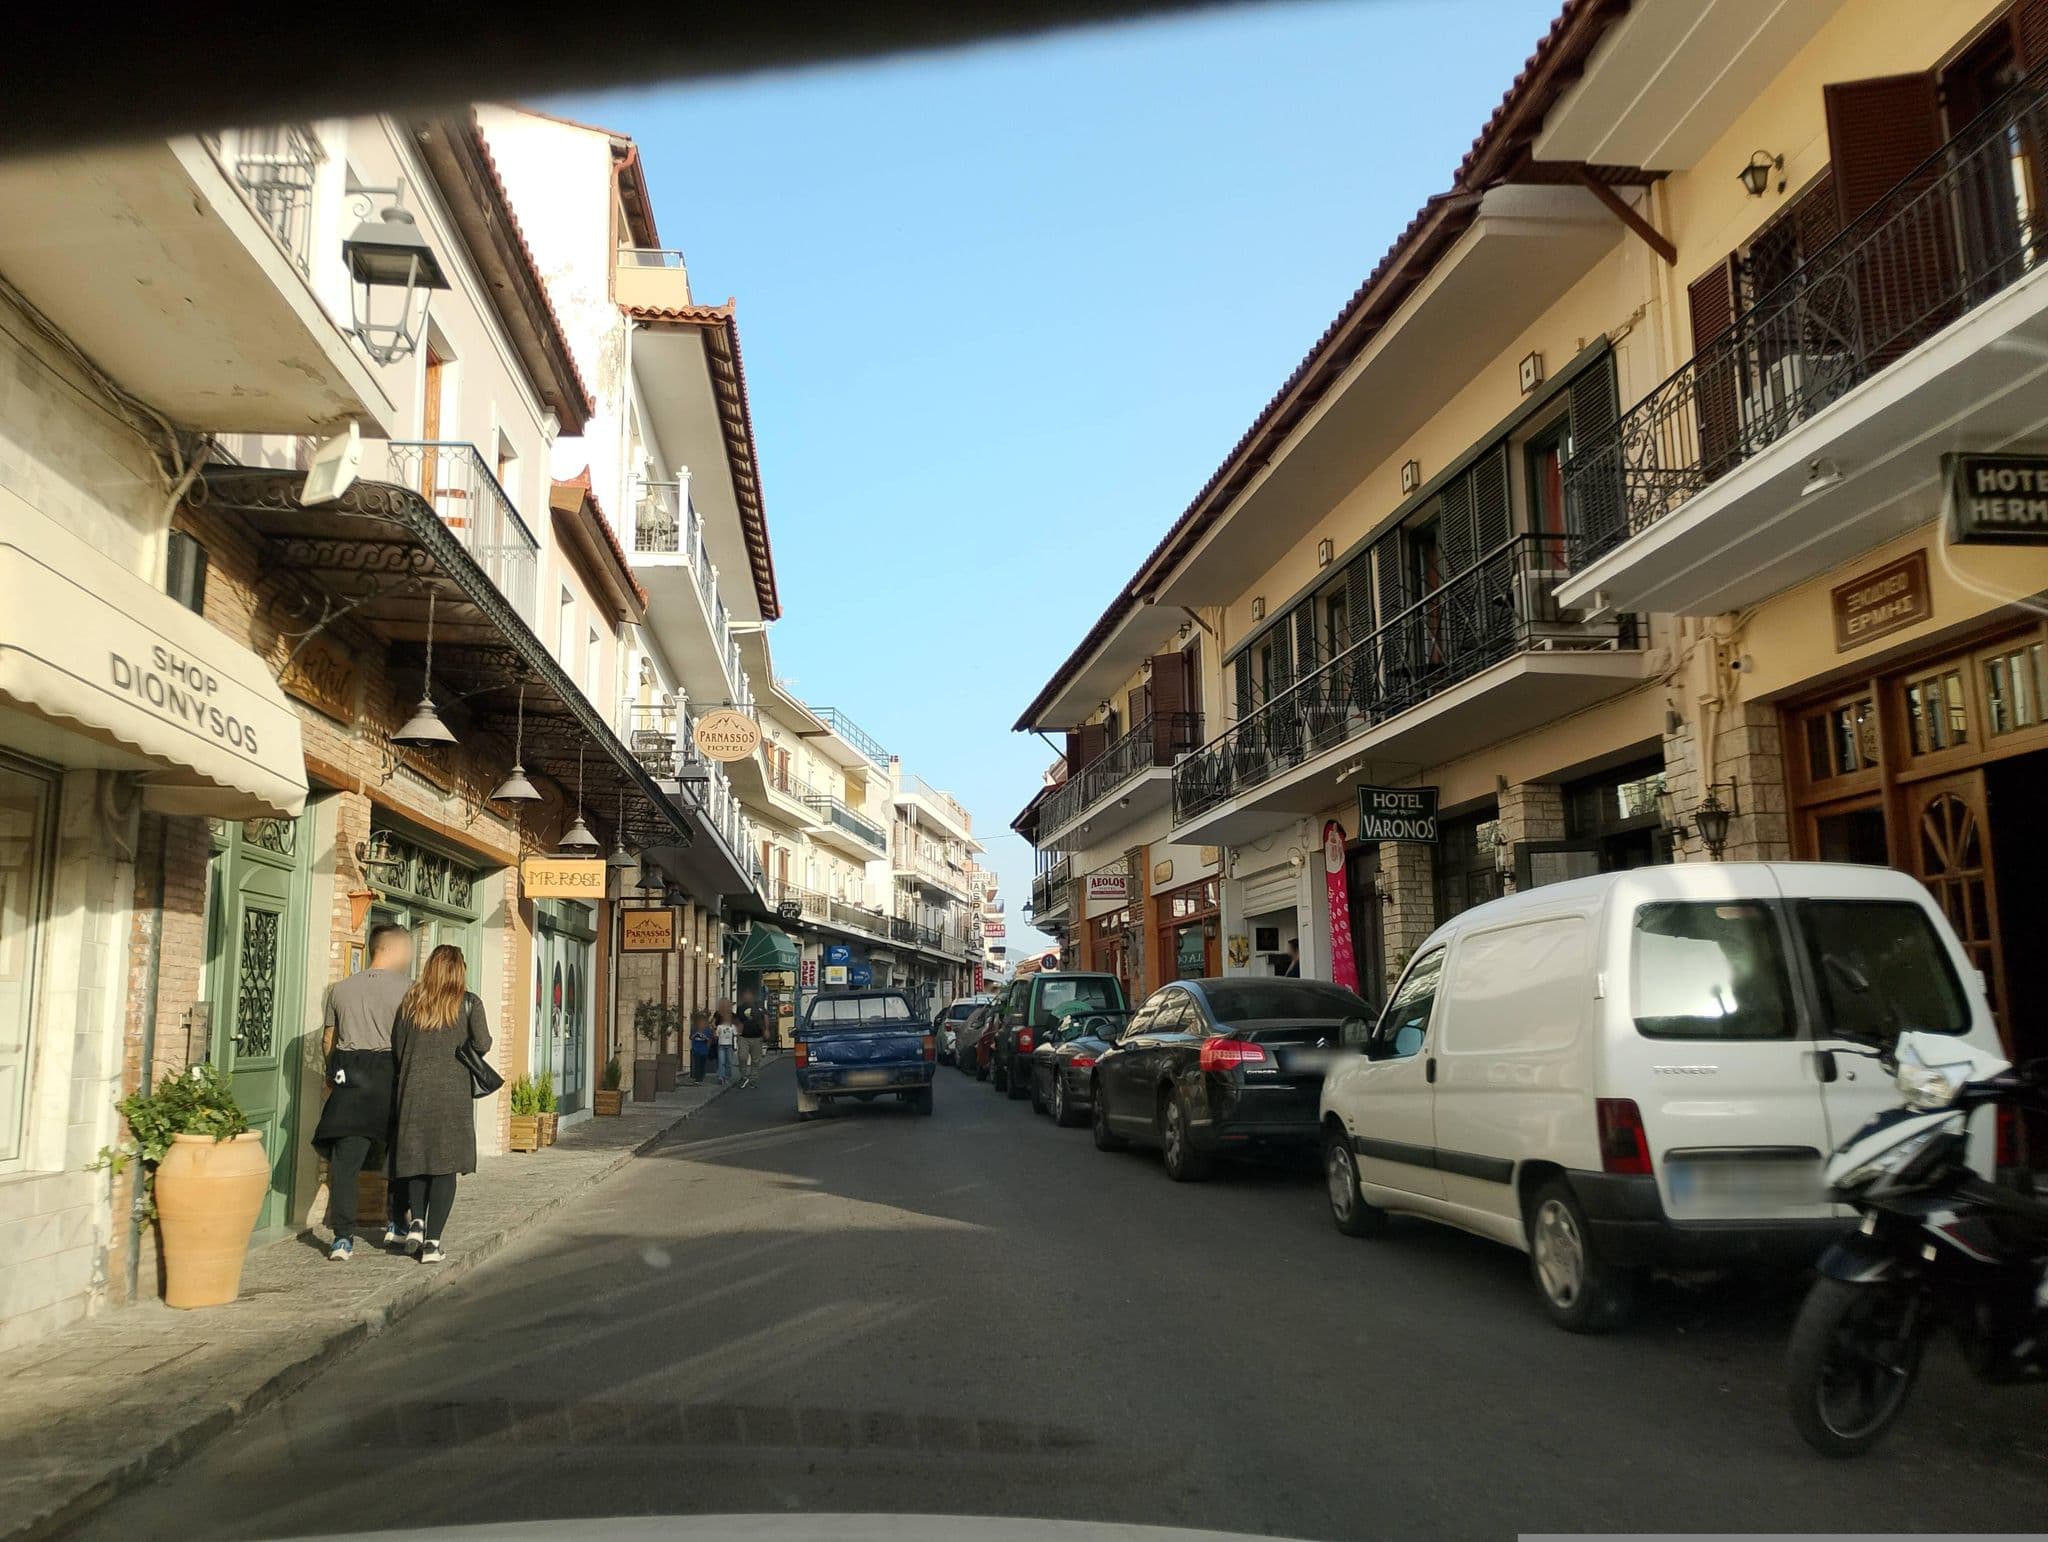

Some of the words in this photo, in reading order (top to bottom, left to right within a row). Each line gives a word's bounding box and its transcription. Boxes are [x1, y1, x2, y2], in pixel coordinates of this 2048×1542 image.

[1976, 469, 2048, 493] HOTE
[153, 645, 218, 697] SHOP
[111, 652, 258, 755] DIONYSOS
[699, 730, 755, 744] PARNASSOS
[1373, 792, 1424, 809] HOTEL
[1363, 814, 1435, 839] VARONOS
[1091, 877, 1126, 889] AEOLOS
[626, 929, 671, 938] PARNASSOS
